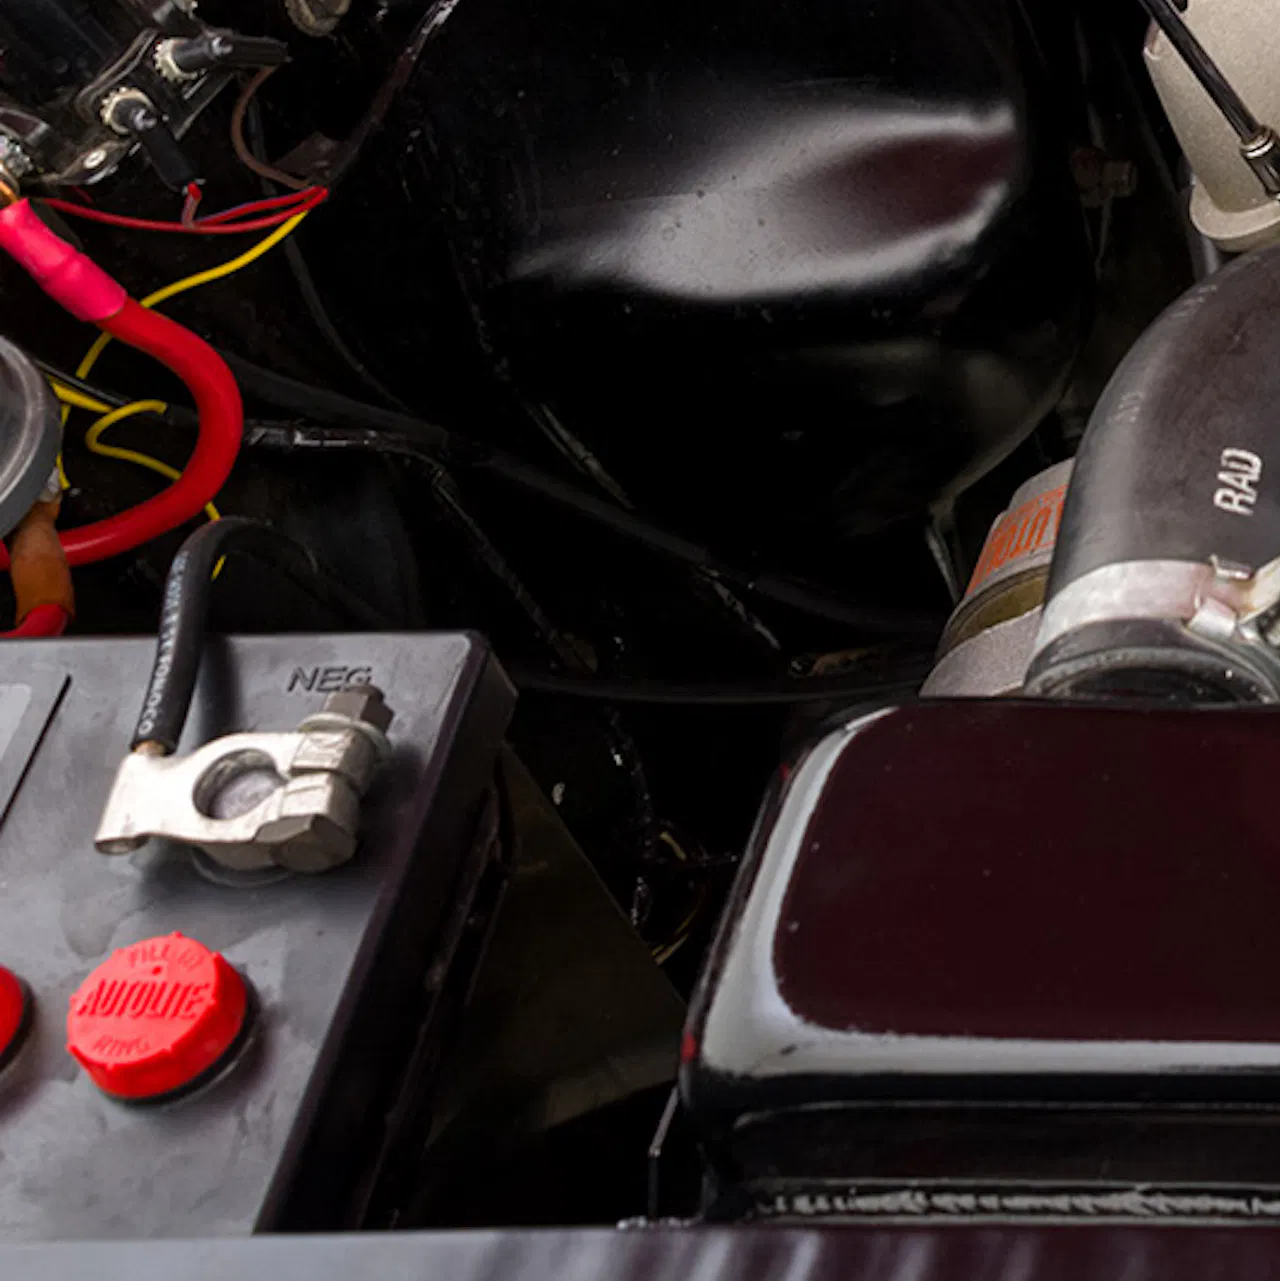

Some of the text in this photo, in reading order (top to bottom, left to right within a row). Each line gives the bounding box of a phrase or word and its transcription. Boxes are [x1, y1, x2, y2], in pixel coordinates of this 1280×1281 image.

[1213, 447, 1264, 516] RAD
[286, 665, 372, 694] NEG
[76, 977, 211, 1020] AUTOLITE
